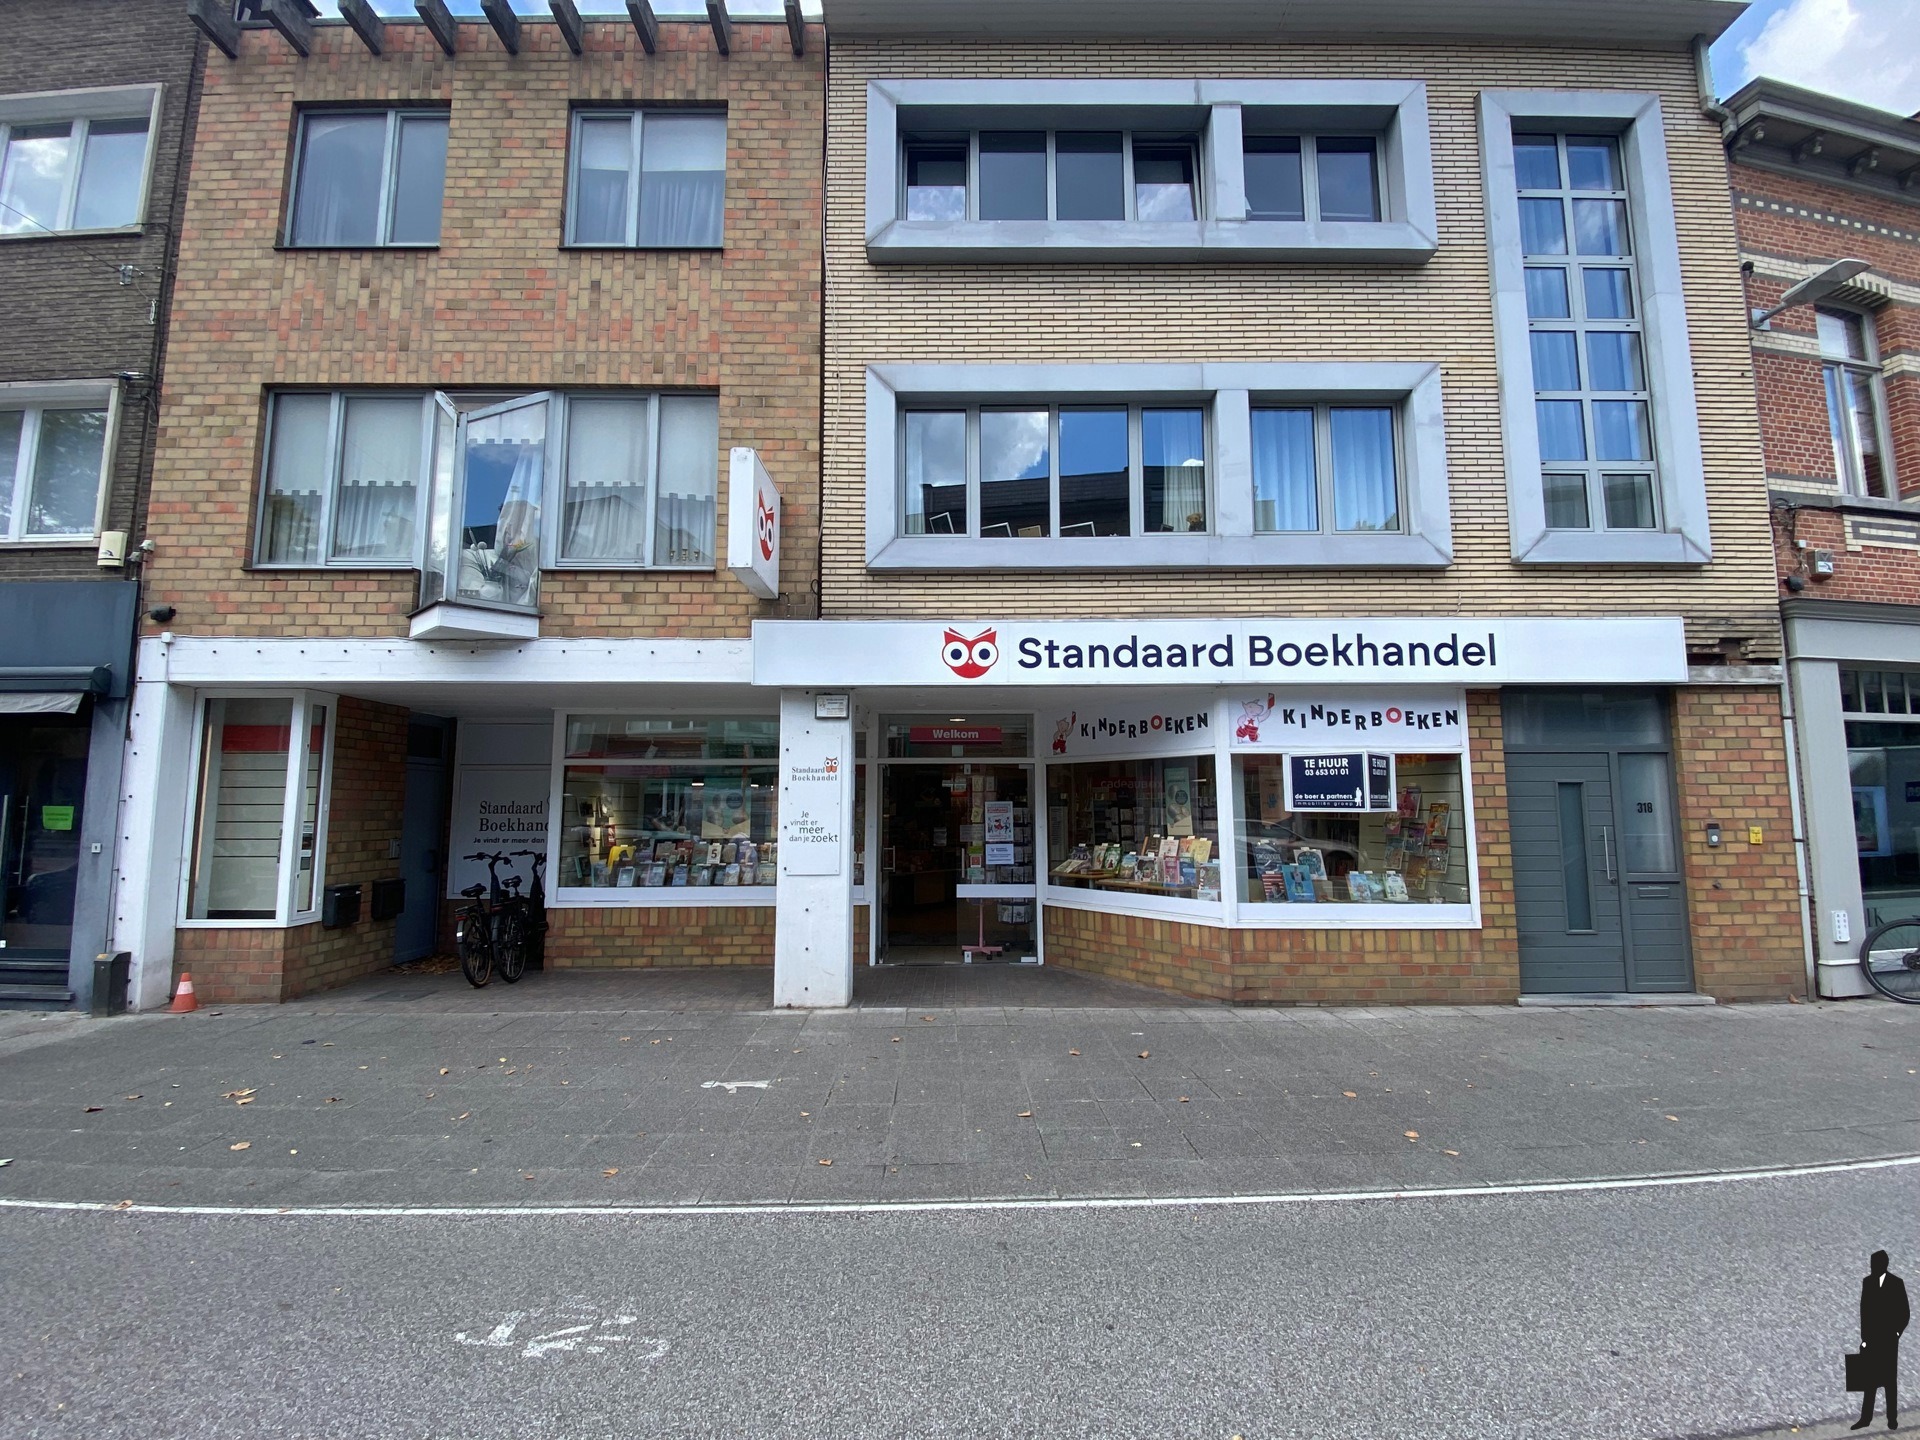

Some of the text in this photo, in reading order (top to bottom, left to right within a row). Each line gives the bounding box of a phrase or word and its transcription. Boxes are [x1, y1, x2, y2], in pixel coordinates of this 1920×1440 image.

[1018, 633, 1497, 668] Standaard Boekhandel
[1283, 704, 1459, 730] KINDERBOEKEN
[1081, 712, 1208, 740] KINDERBOEKEN
[932, 729, 979, 739] Welkom
[1304, 758, 1349, 768] TE HUUR
[479, 800, 543, 814] Standaard
[1637, 802, 1653, 813] 318
[799, 826, 824, 834] meer
[803, 835, 810, 843] je
[811, 833, 838, 843] zoekt
[711, 849, 718, 859] 5
